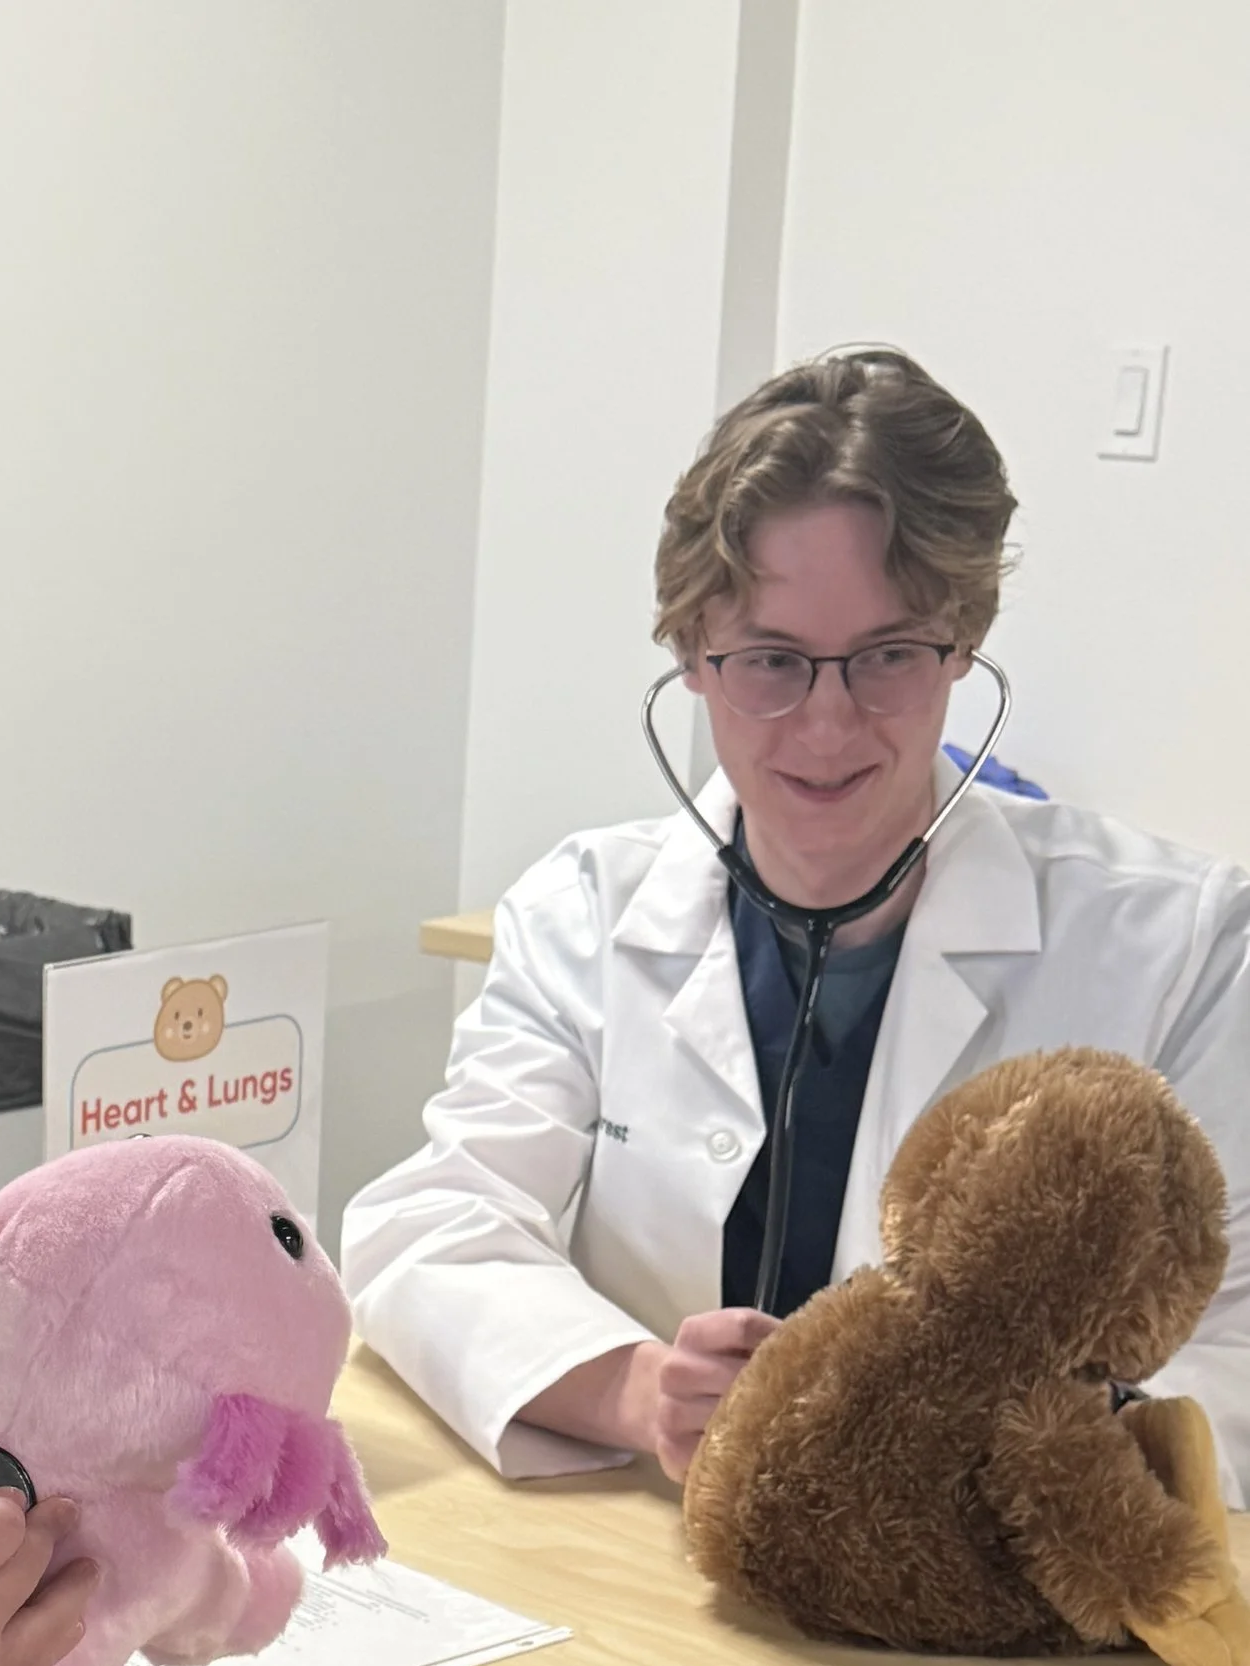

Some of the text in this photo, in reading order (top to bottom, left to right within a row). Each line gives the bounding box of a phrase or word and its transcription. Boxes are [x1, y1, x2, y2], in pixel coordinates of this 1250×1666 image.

[80, 1066, 293, 1135] Heart & Lungs
